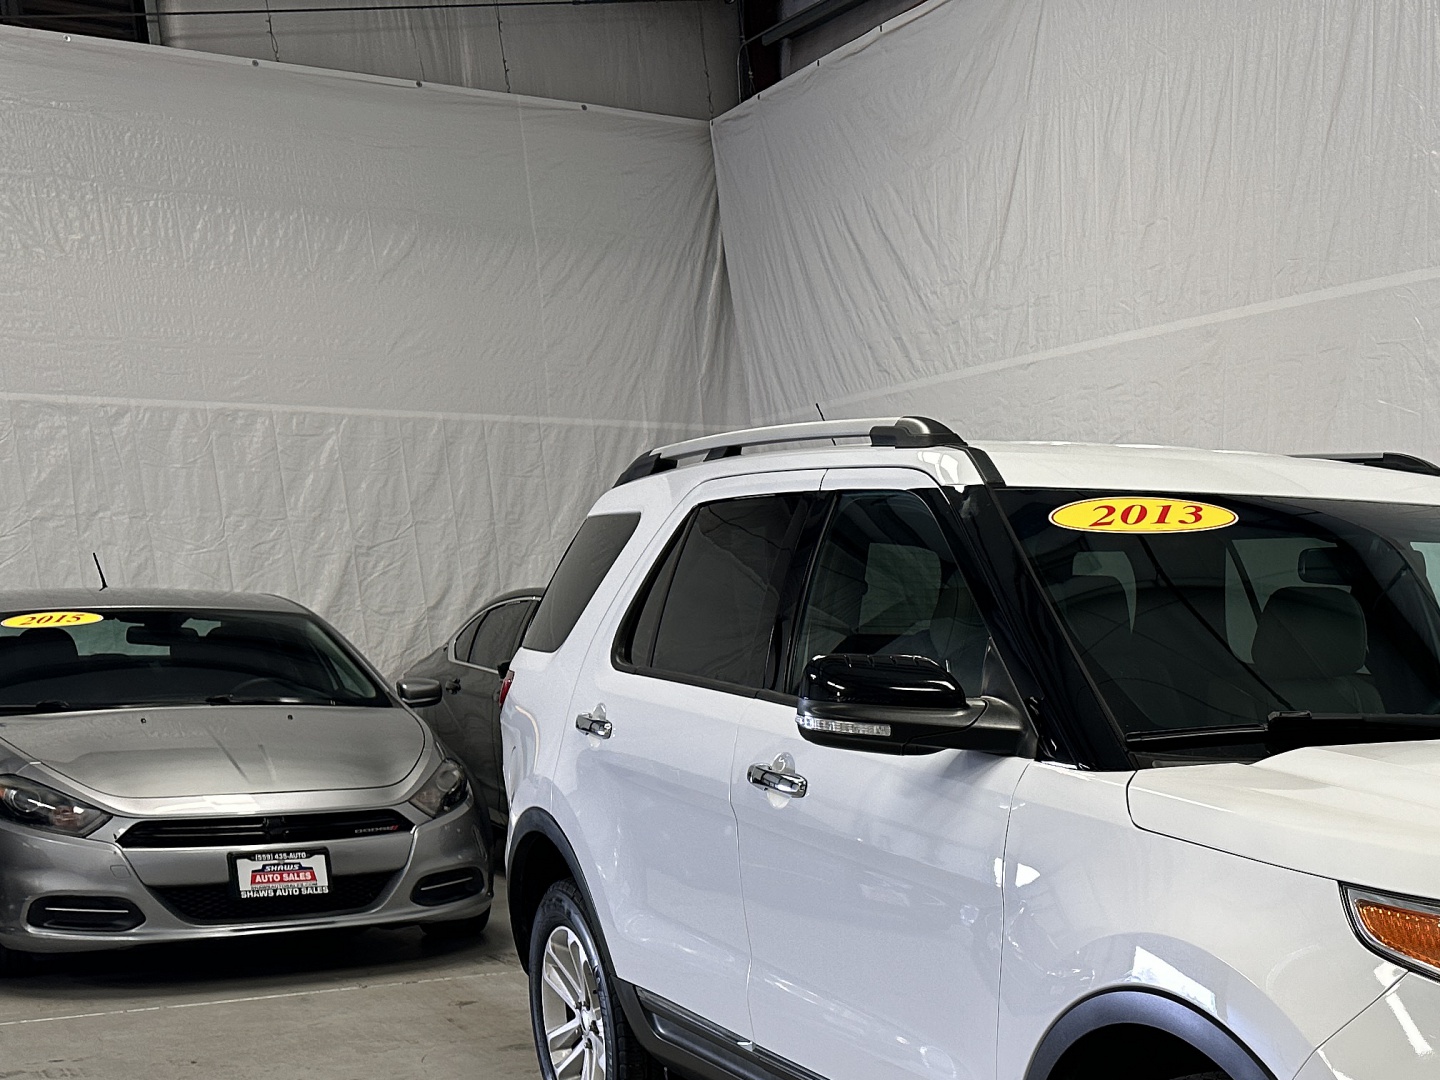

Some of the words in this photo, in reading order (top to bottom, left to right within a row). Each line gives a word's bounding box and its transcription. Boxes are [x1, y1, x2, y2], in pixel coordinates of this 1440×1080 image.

[1089, 504, 1203, 527] 2013
[20, 614, 85, 625] 2015
[264, 863, 300, 872] SHAWS
[255, 874, 281, 883] AUTO
[282, 871, 312, 882] SALES
[241, 889, 274, 898] SHAWS
[275, 887, 300, 896] AUTO
[301, 885, 329, 894] SALES
